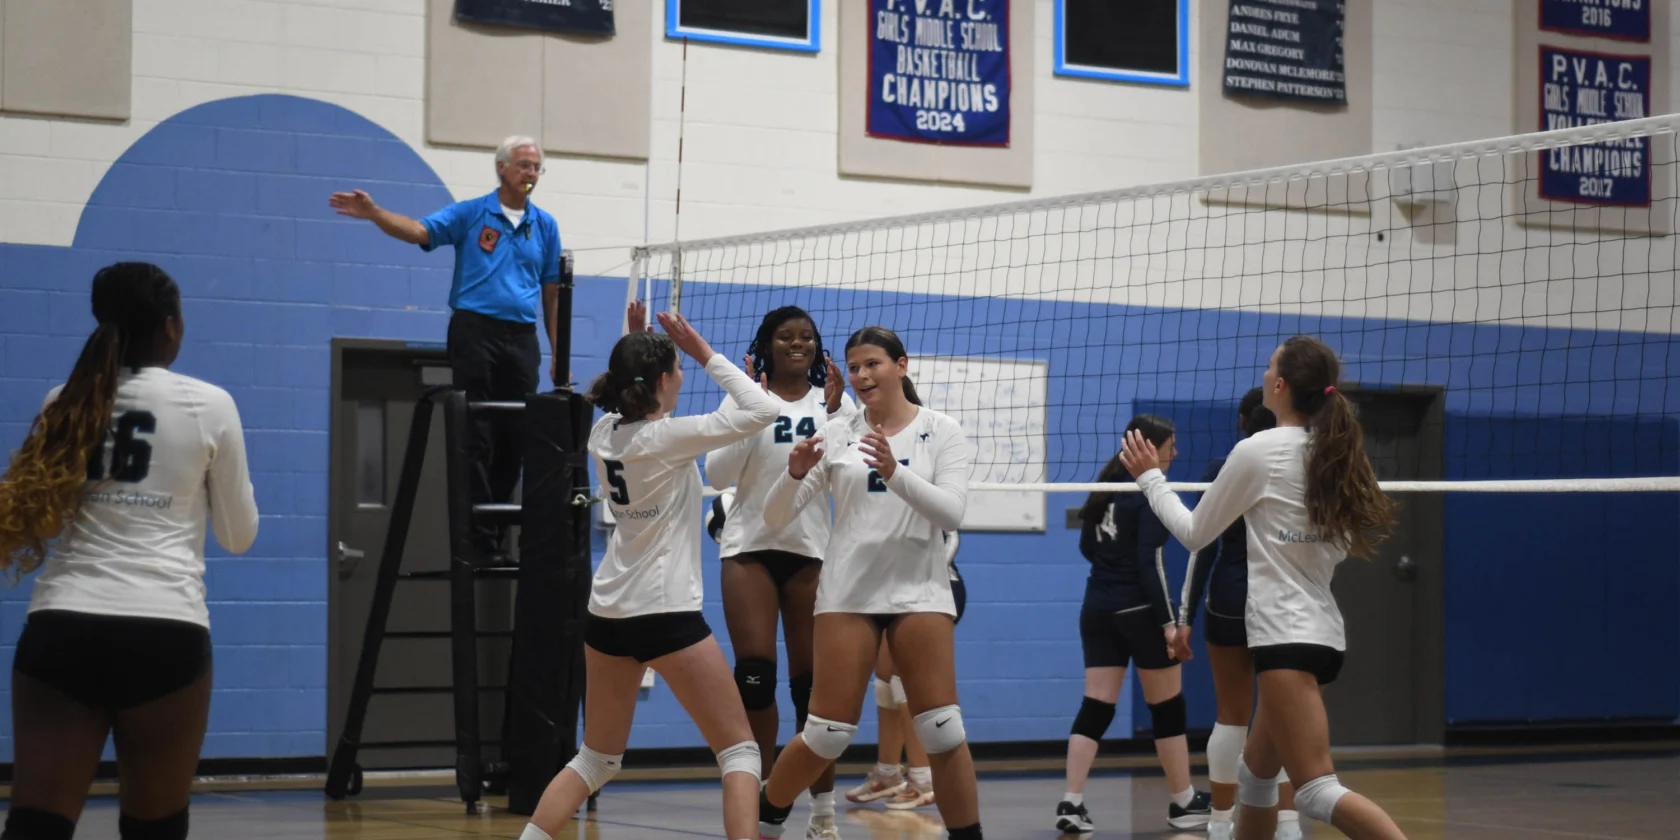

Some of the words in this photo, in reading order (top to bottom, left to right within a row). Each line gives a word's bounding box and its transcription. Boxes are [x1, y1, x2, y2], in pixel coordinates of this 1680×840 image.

[1274, 11, 1299, 24] FRYE
[1581, 6, 1612, 27] 2016
[877, 11, 909, 43] GIRLS
[915, 17, 955, 48] MIDDLE
[960, 22, 1002, 52] SCHOOL
[1230, 21, 1269, 37] DANIEL
[1271, 28, 1300, 42] ADUM
[1230, 39, 1256, 52] MAX
[1257, 43, 1304, 60] GREGORY
[896, 45, 980, 81] BASKETBALL
[1226, 57, 1277, 74] DONOVAN
[882, 73, 999, 112] CHAMPIONS
[1226, 75, 1276, 91] STEPHEN
[916, 110, 965, 132] 2024
[1550, 145, 1642, 178] CHAMPIONS
[1579, 176, 1613, 198] 2017
[774, 415, 816, 444] 24
[602, 459, 630, 505] 5
[115, 489, 173, 509] School
[625, 505, 660, 519] School
[1278, 530, 1322, 543] McLea
